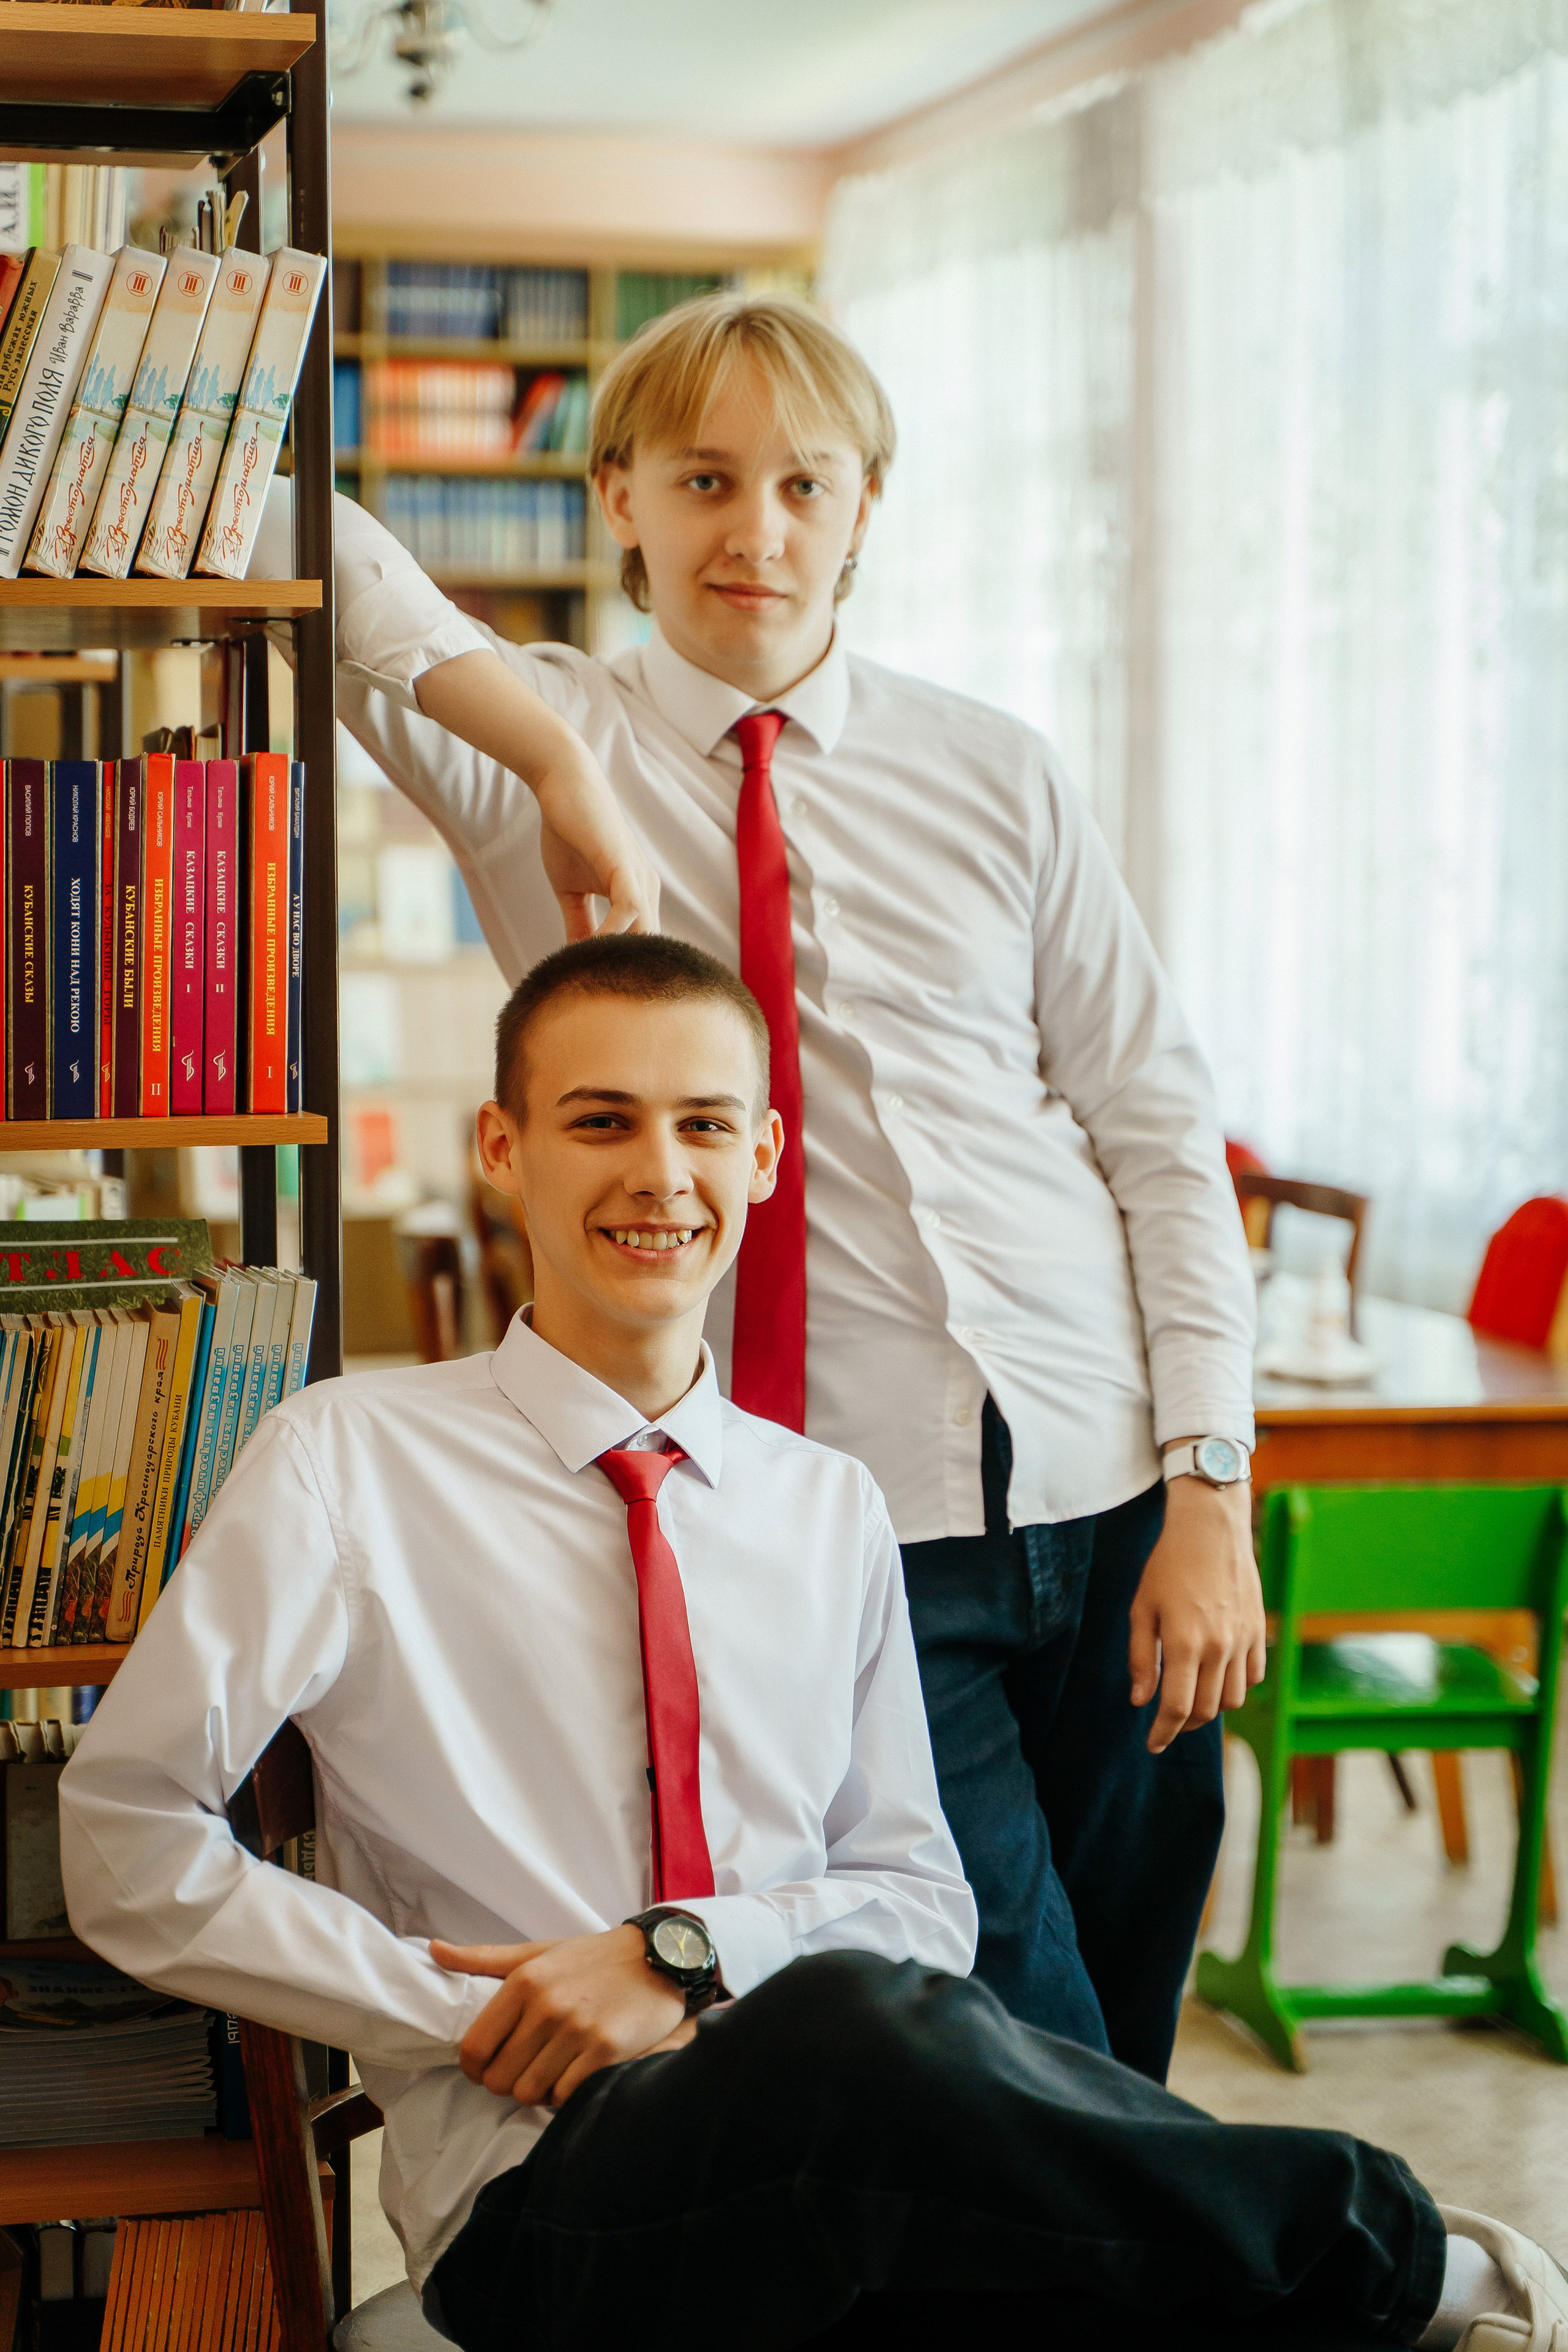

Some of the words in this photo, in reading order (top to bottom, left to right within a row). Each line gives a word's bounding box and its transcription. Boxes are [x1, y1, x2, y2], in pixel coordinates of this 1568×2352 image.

[1, 326, 22, 372] рубежах
[18, 280, 37, 322] южных
[2, 368, 18, 392] Русь
[14, 309, 37, 364] залесская
[49, 335, 68, 364] Иван
[59, 286, 86, 333] Варавва
[12, 415, 50, 486] ДИКОГО
[32, 368, 64, 415] ПОЛЯ
[55, 421, 98, 559] Хрестоматия
[106, 421, 150, 559] Хрестоматия
[166, 421, 205, 560] Хрестоматия
[222, 421, 260, 560] Хрестоматия
[70, 878, 80, 918] ХОДЯТ
[105, 883, 112, 896] ЗА
[153, 878, 164, 952] ИЗБРАННЫЕ
[184, 850, 195, 913] КАЗАЦКИЕ
[216, 850, 226, 913] КАЗАЦКИЕ
[266, 862, 276, 936] ИЗБРАННЫЕ
[24, 885, 34, 959] КУБАНСКИЕ
[71, 921, 80, 956] КОНИ
[104, 906, 112, 980] КУДЫКИНЫ
[124, 885, 135, 965] КУБАНСКИЕ
[185, 922, 195, 969] СКАЗКИ
[216, 922, 226, 969] СКАЗКИ
[292, 930, 300, 946] ВО
[24, 962, 34, 1003] СКАЗЫ
[69, 960, 80, 985] НАД
[124, 969, 134, 1008] БЫЛИ
[216, 984, 224, 993] II
[266, 938, 276, 1036] ПРОИЗВЕДЕНИЯ
[291, 946, 300, 978] ДВОРЕ
[70, 988, 80, 1033] РЕКОЮ
[151, 955, 163, 1052] ПРОИЗВЕДЕНИЯ
[151, 1083, 161, 1096] II
[154, 1370, 165, 1404] края
[225, 1344, 244, 1417] названий
[246, 1344, 265, 1418] названий
[135, 1411, 159, 1522] Краснодарского
[154, 1487, 168, 1548] ПАМЯТНИКИ
[163, 1437, 176, 1483] ПРИРОДЫ
[172, 1394, 183, 1433] КУБАНИ
[189, 1426, 213, 1544] ографических
[207, 1348, 226, 1421] названий
[126, 1527, 145, 1589] Природа
